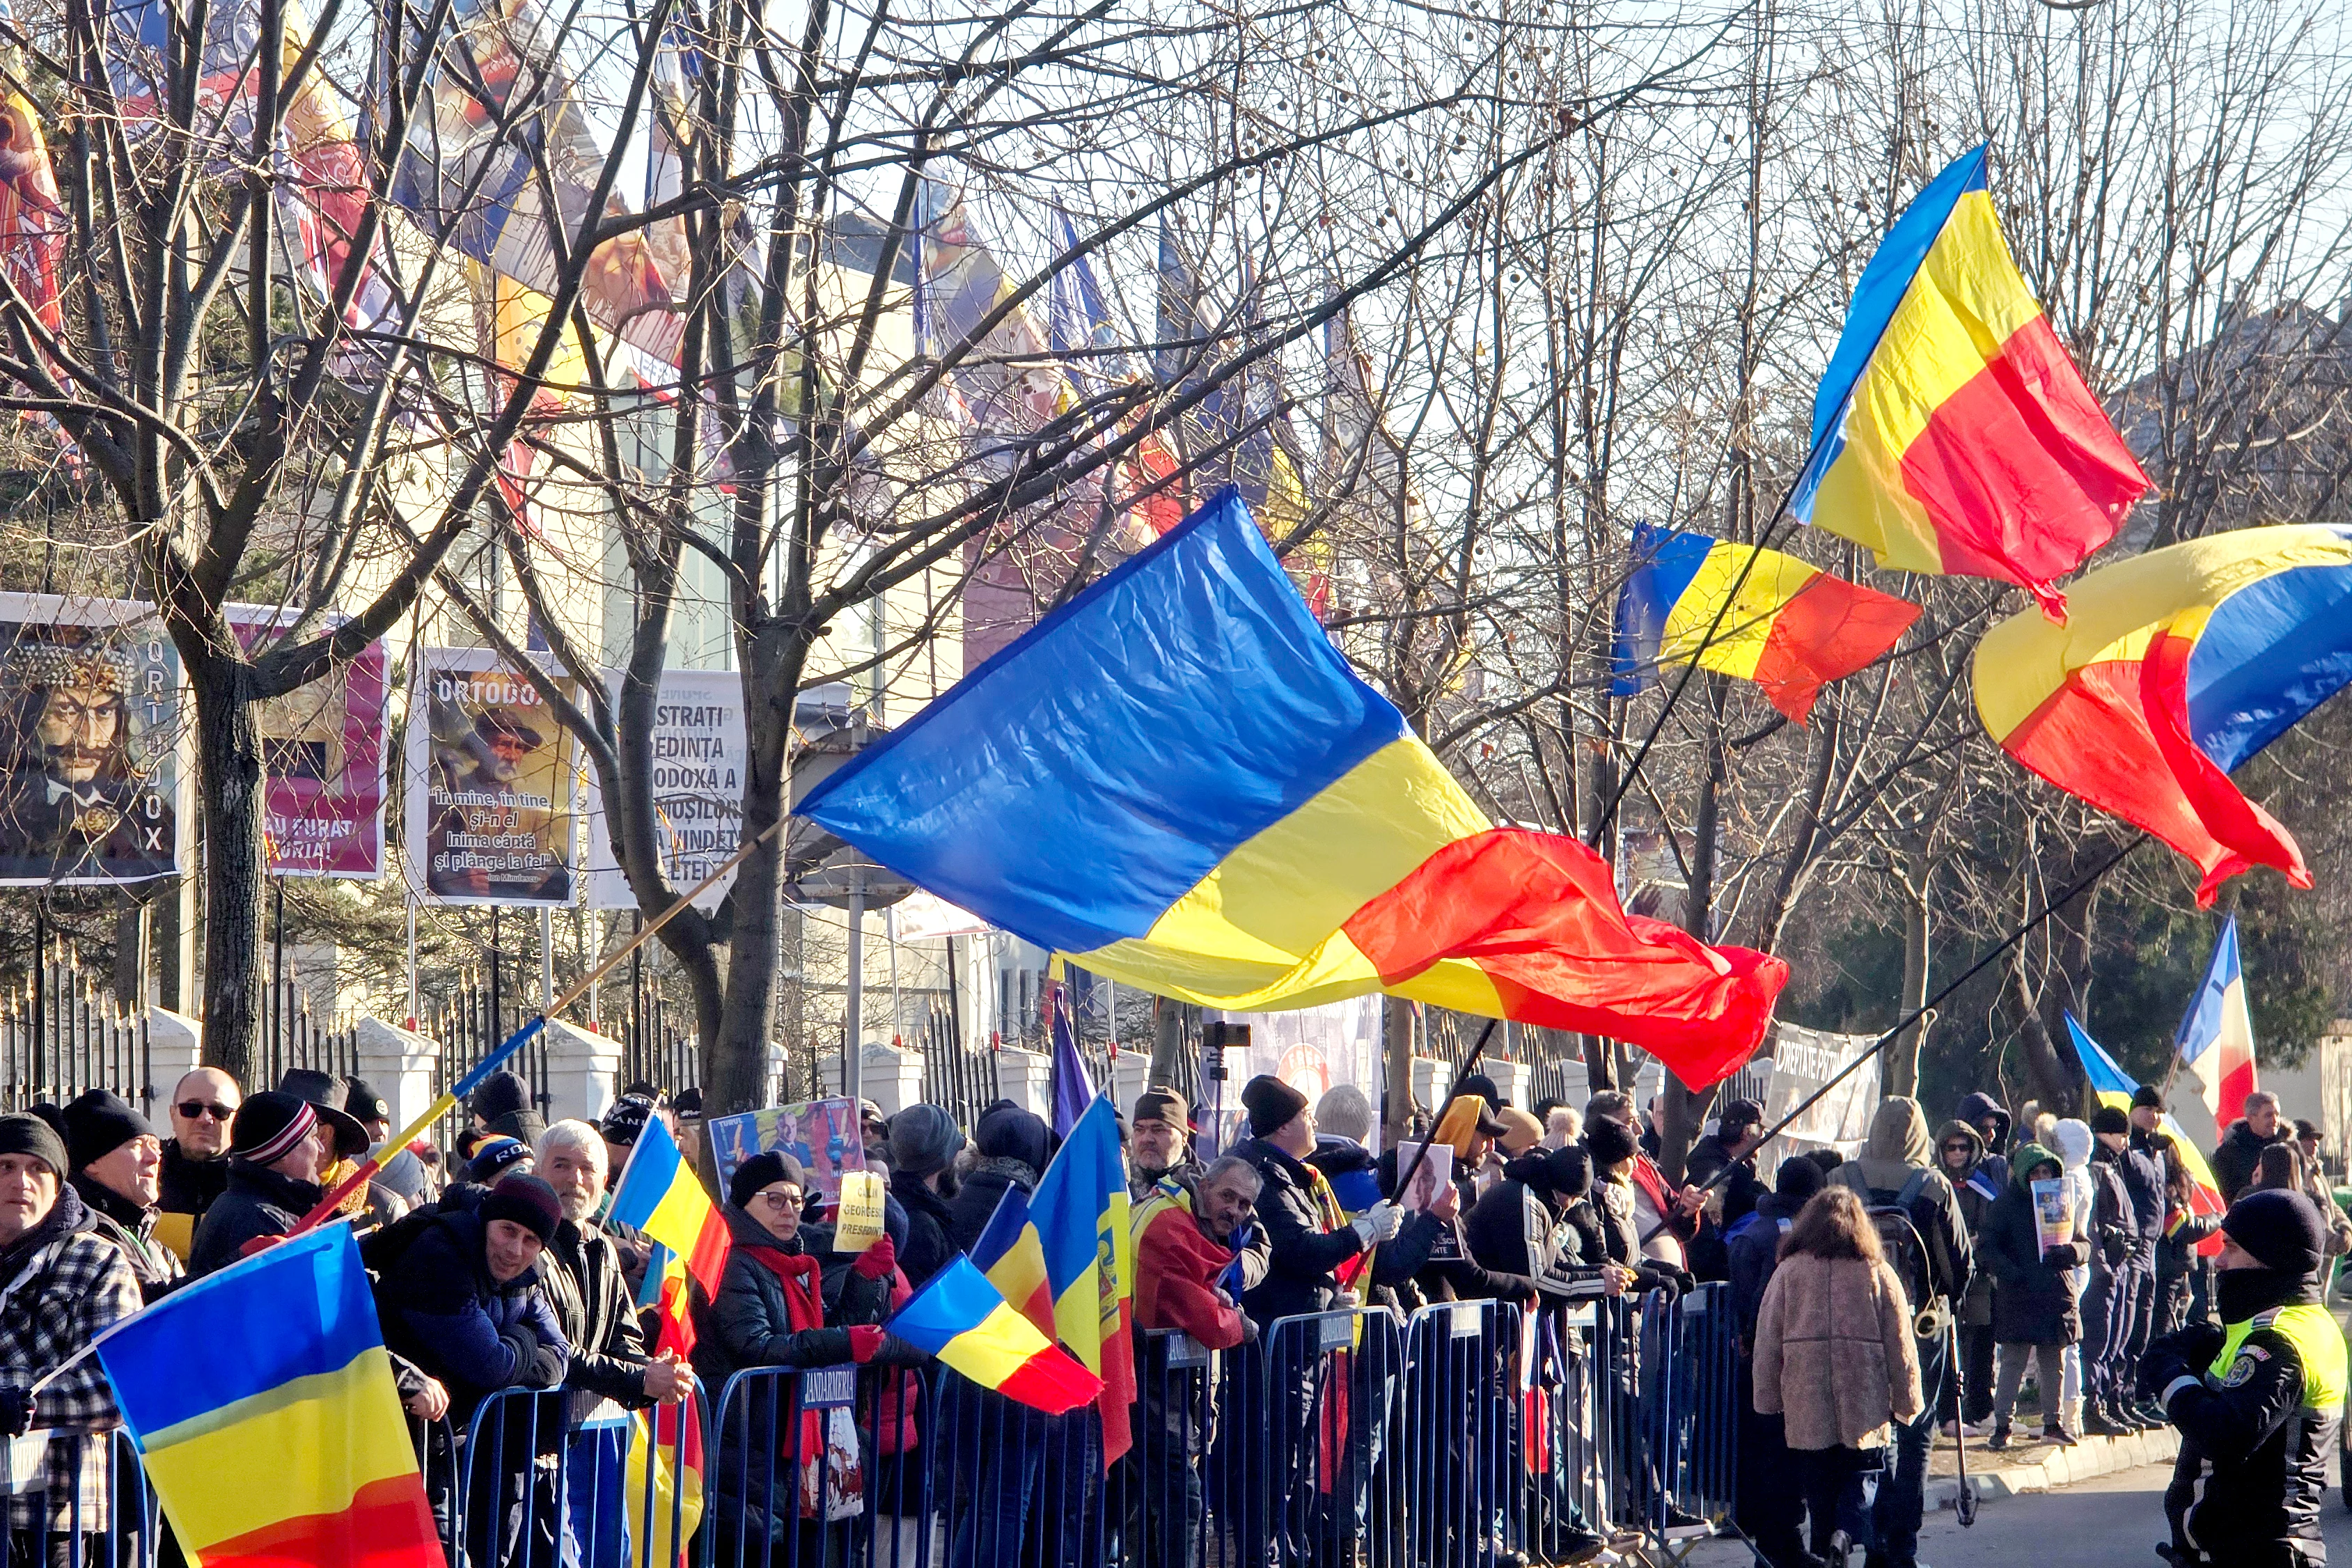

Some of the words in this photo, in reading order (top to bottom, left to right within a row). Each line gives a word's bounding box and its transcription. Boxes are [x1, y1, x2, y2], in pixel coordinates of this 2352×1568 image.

[438, 679, 544, 705] ORTODO
[145, 639, 164, 851] ORTODOX
[724, 768, 737, 789] A
[454, 790, 498, 809] mine,
[499, 791, 516, 806] în
[519, 793, 552, 809] tine,
[504, 811, 518, 826] el
[446, 831, 490, 847] Inima
[493, 832, 536, 849] cântă
[434, 852, 449, 872] și
[452, 852, 505, 872] plânge
[508, 853, 522, 869] la
[1288, 1049, 1321, 1069] FREE
[805, 1370, 854, 1404] JANDARMERIA
